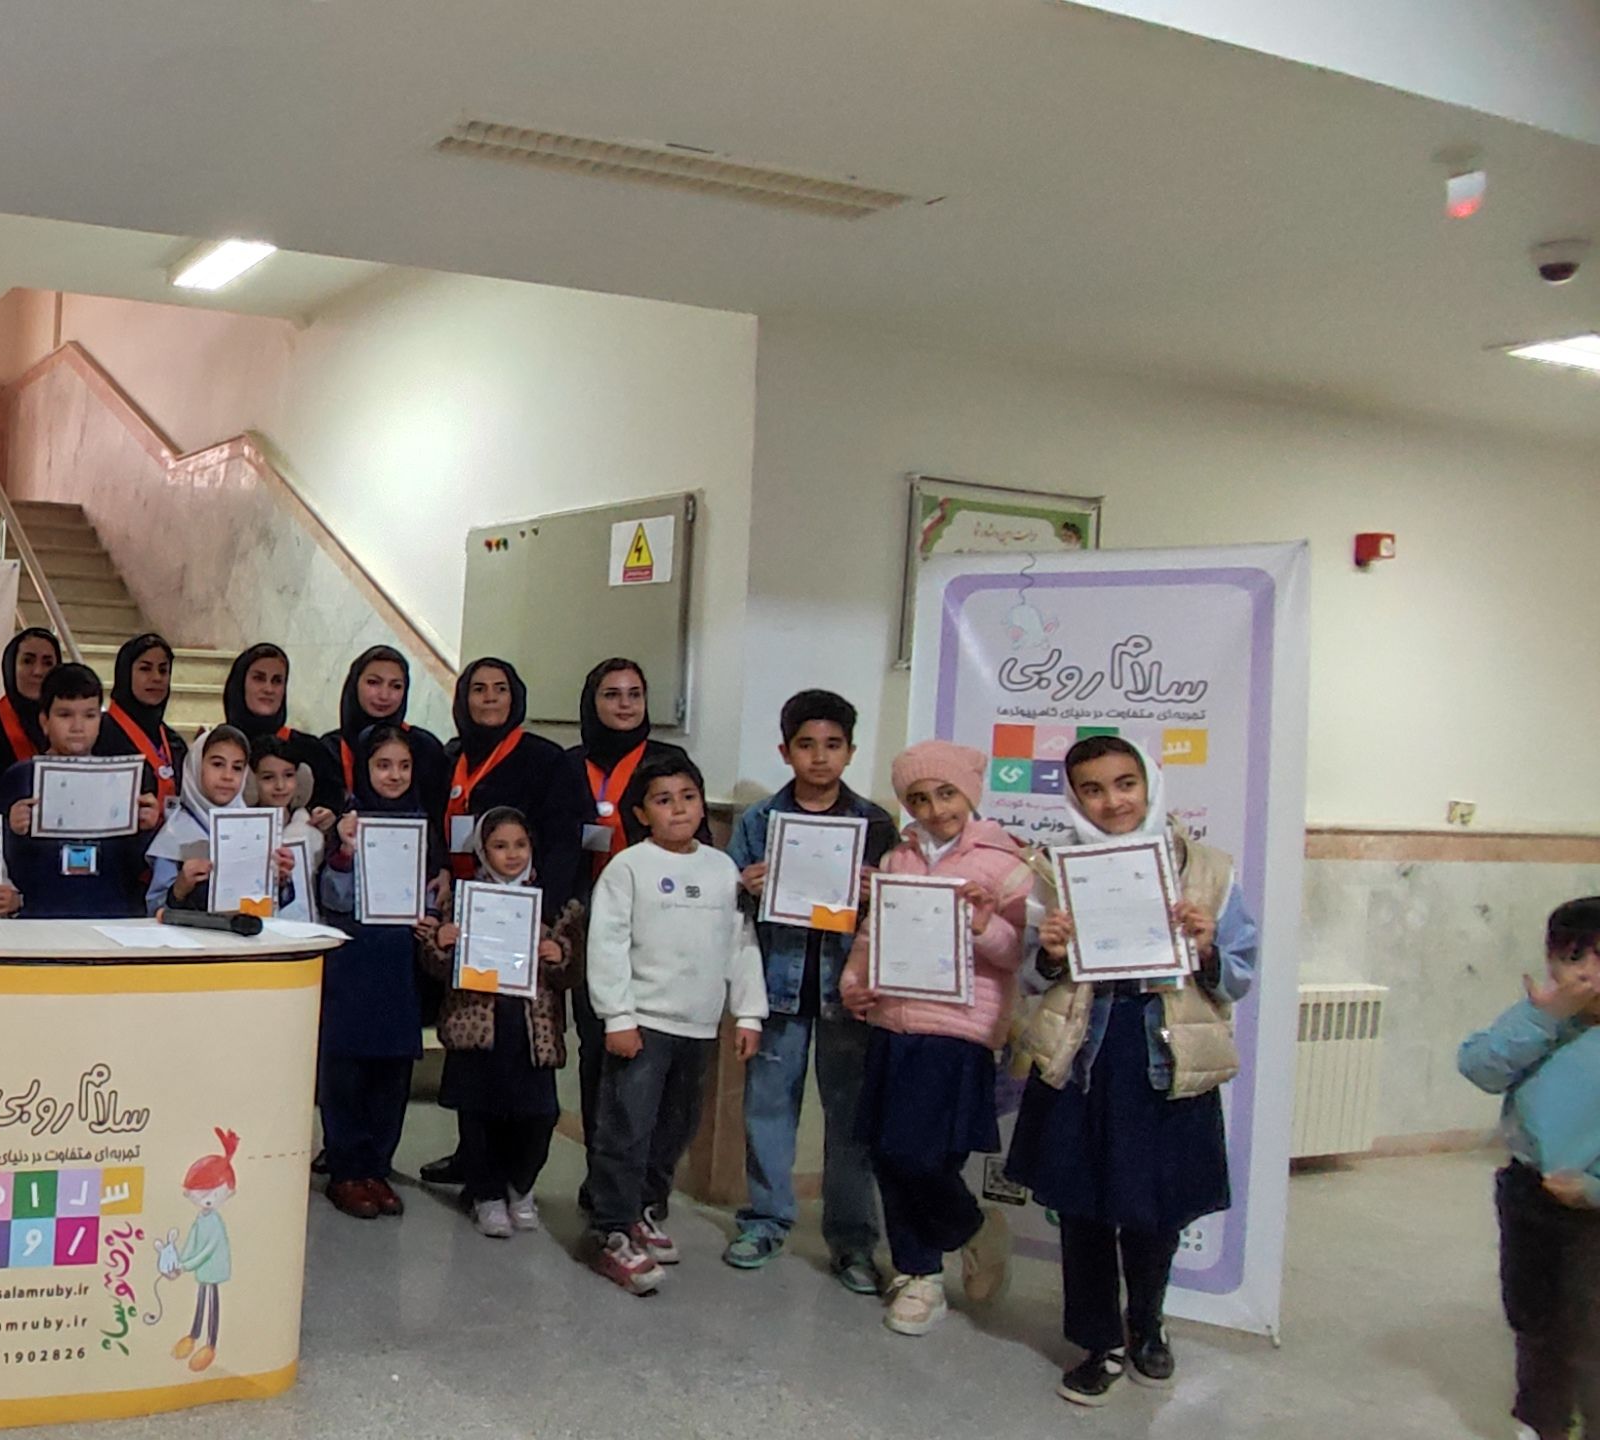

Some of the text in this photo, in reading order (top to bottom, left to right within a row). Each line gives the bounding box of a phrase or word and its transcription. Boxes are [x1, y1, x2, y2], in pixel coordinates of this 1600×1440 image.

[998, 634, 1209, 703] سلام روبی
[996, 706, 1059, 720] کامپیوترها
[1059, 707, 1091, 719] دنیای
[1105, 708, 1155, 720] متفاوت
[78, 1063, 151, 1135] سلام
[31, 1152, 43, 1165] در
[43, 1147, 93, 1165] متفاوت
